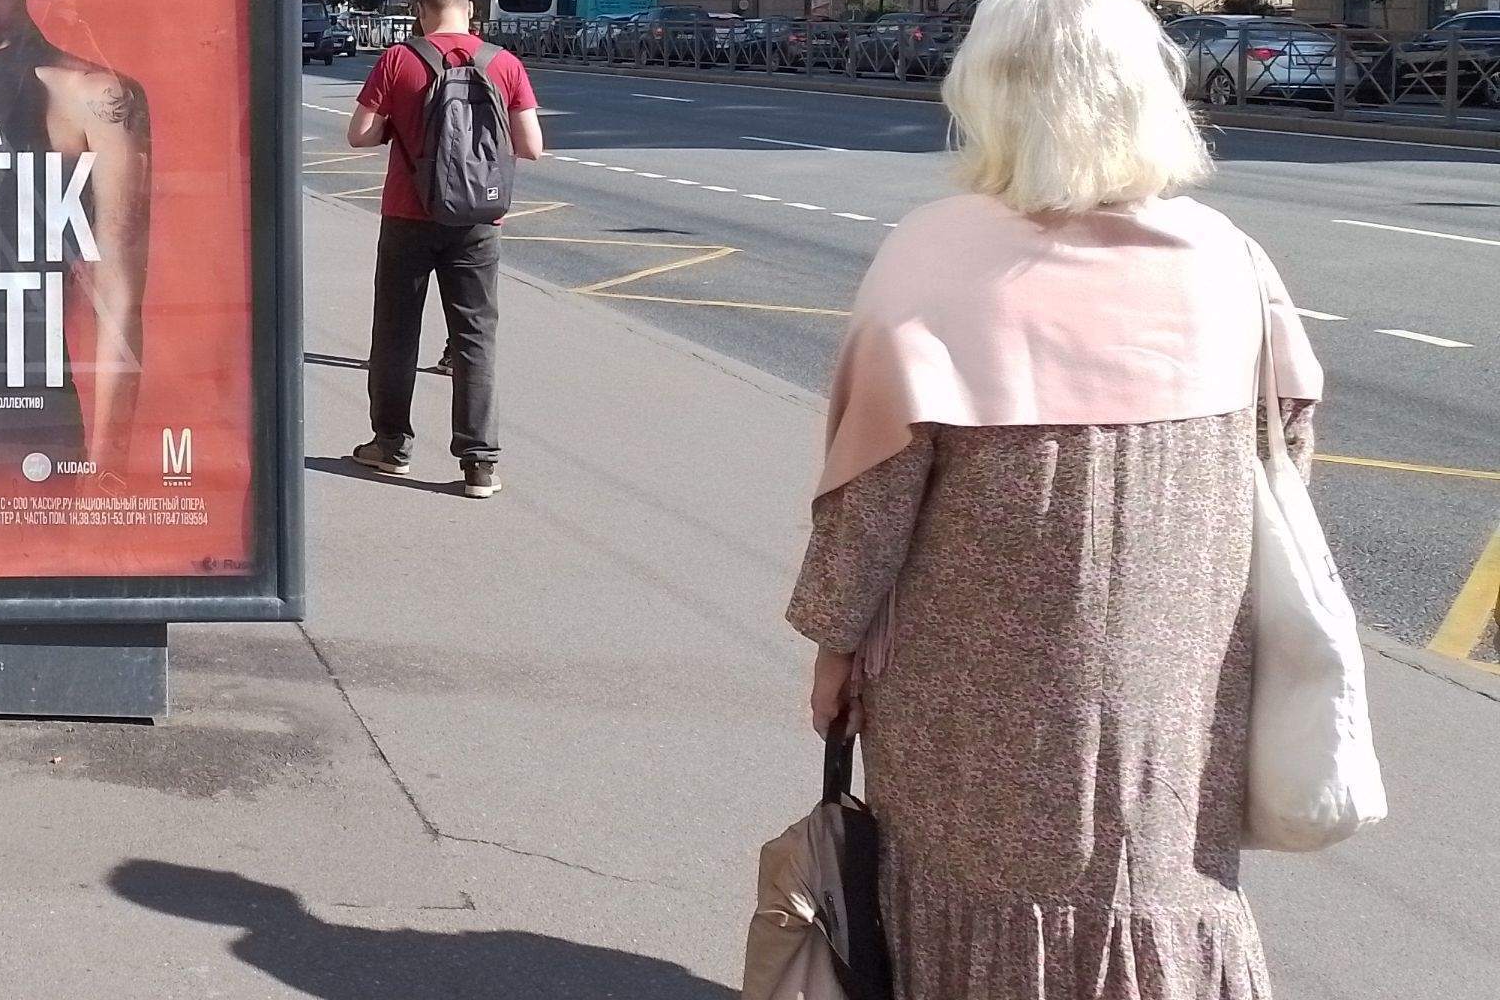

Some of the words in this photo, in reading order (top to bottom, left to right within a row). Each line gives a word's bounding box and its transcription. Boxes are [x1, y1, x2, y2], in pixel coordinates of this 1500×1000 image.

[57, 459, 97, 475] KUDAGO
[75, 495, 136, 511] НАЦИОНАЛЬНЫЙ
[138, 495, 179, 510] БИЛЕТНЫЙ
[24, 512, 47, 525] ЧАСТЬ
